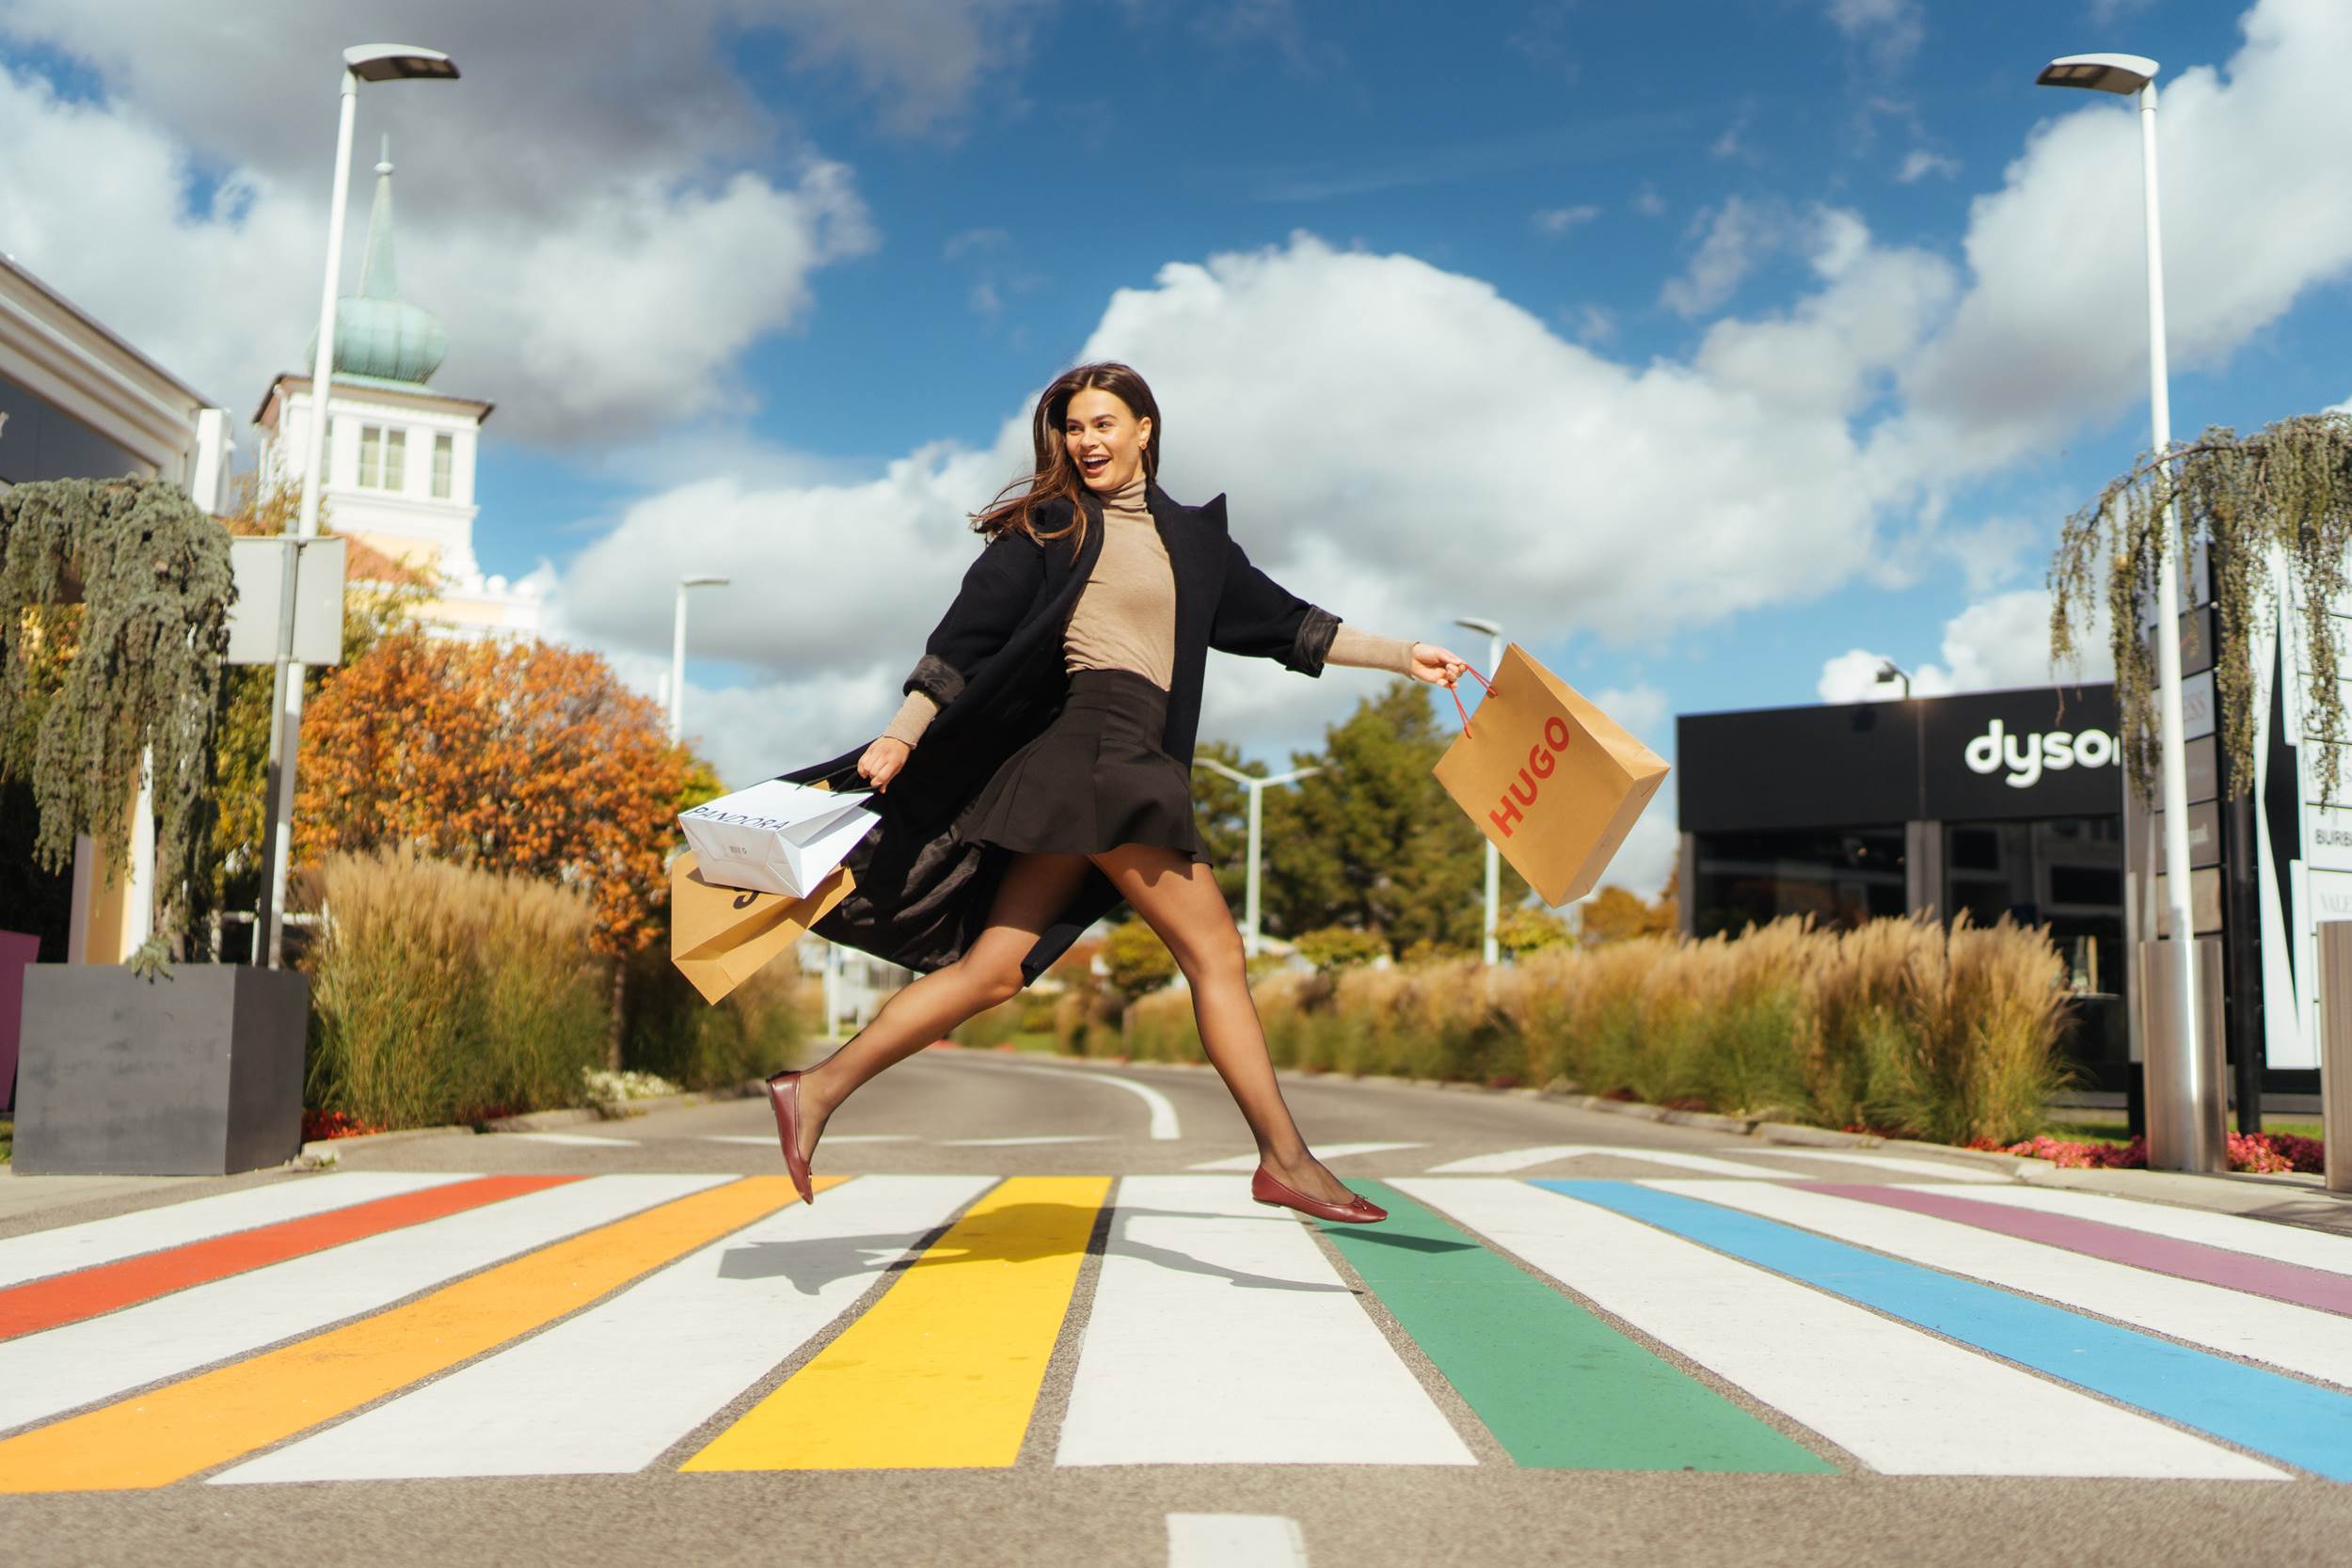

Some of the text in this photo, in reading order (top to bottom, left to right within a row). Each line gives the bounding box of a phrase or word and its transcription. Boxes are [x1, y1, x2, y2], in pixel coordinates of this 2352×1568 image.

[1488, 716, 1569, 837] HUGO
[1964, 718, 2121, 788] dyso
[685, 806, 790, 830] PANDORA
